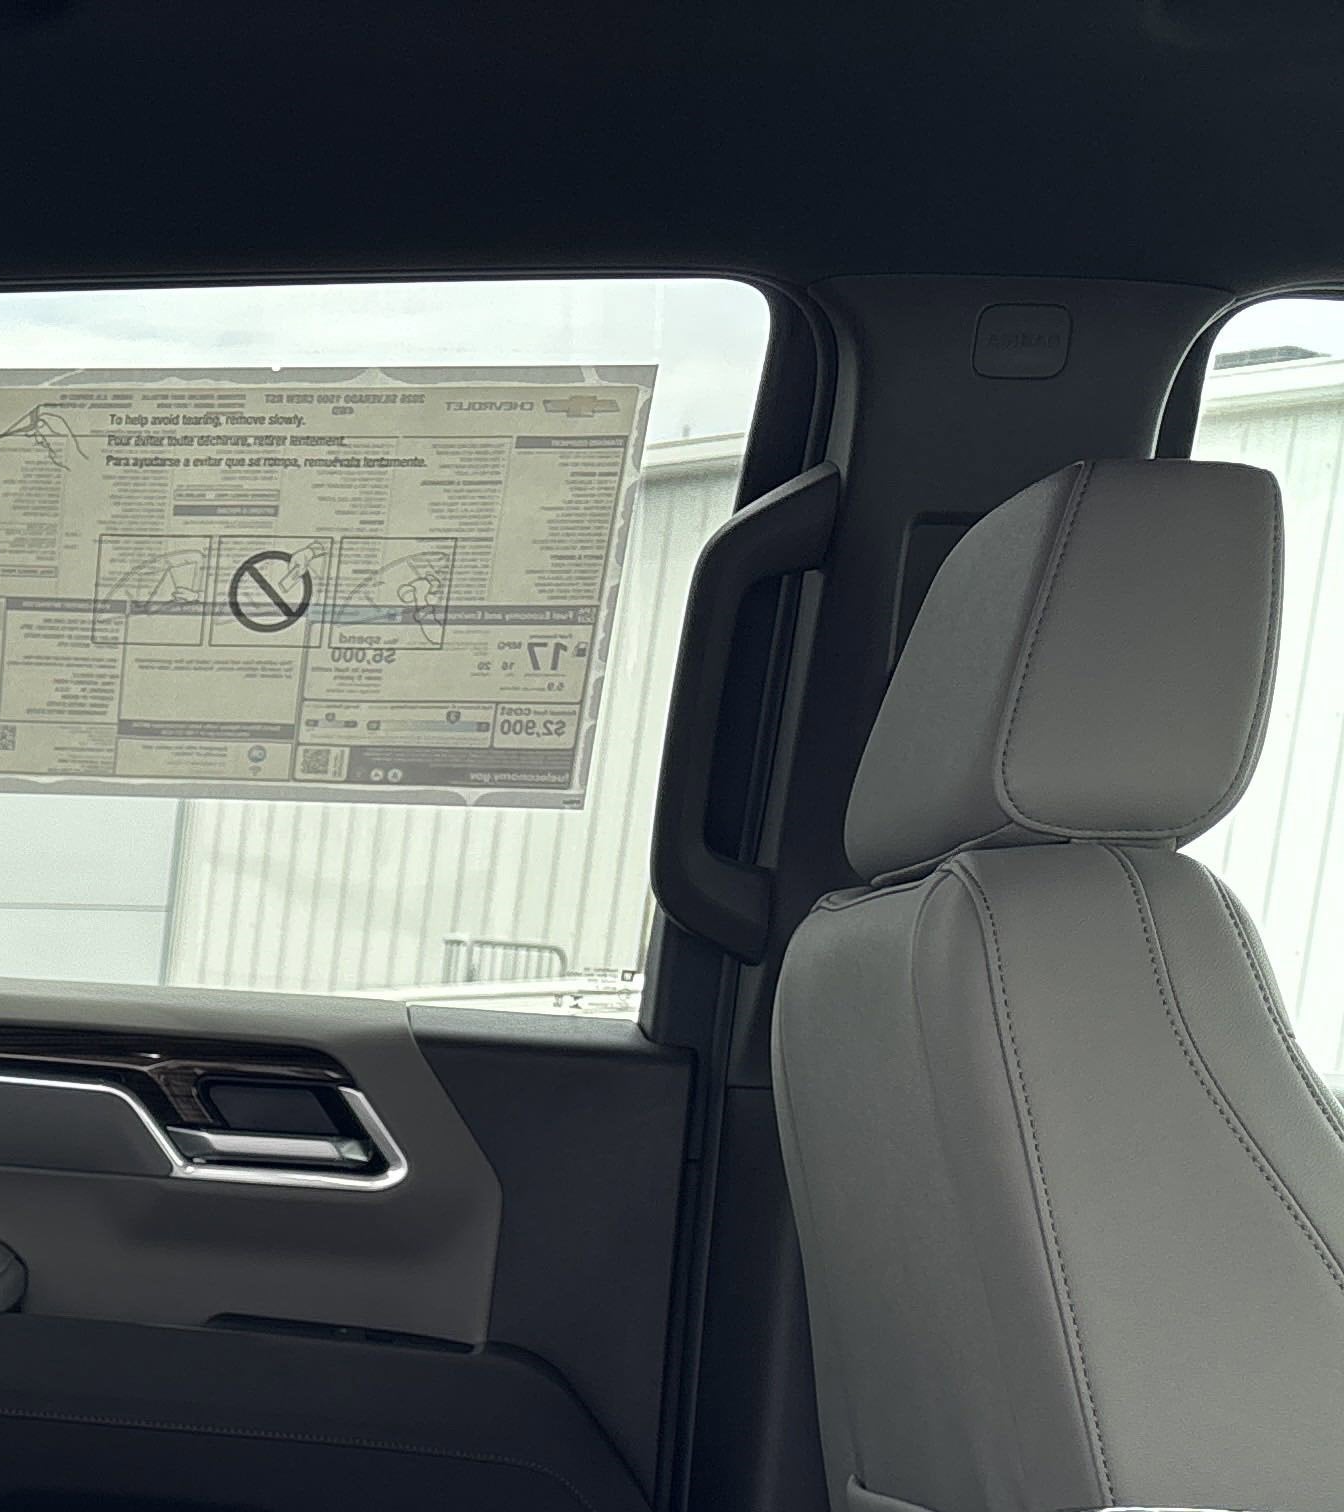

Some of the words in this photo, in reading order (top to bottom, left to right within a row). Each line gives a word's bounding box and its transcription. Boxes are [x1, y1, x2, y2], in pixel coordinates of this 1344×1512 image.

[109, 414, 123, 425] To
[125, 414, 148, 427] help
[150, 414, 180, 425] avoid
[182, 414, 222, 427] tearing,
[225, 415, 266, 425] remove
[268, 414, 306, 428] slowly.
[107, 435, 132, 446] Pour
[167, 435, 194, 446] toute
[105, 455, 130, 466] Para
[132, 455, 180, 468] ayudarse
[183, 458, 190, 467] a
[192, 455, 223, 467] evitar
[225, 457, 246, 468] que
[248, 457, 262, 467] se
